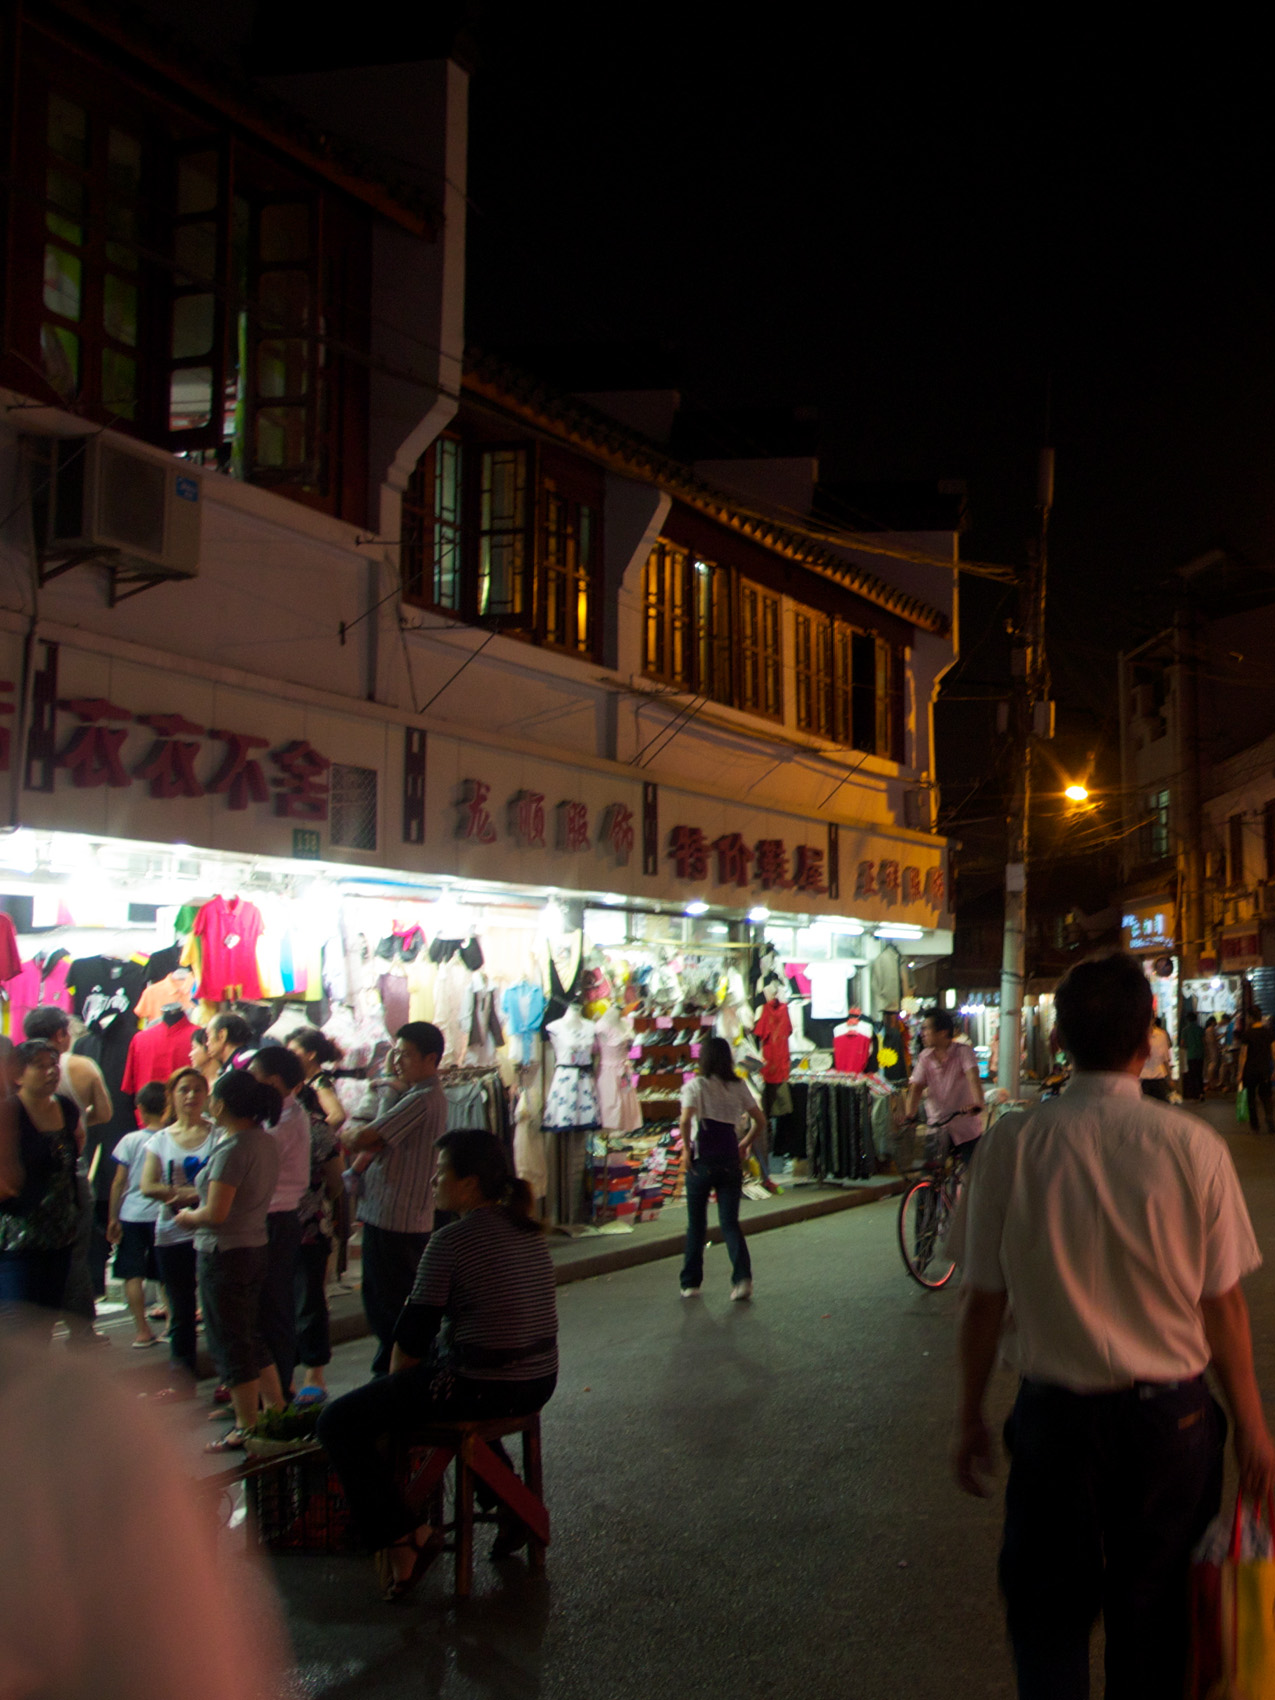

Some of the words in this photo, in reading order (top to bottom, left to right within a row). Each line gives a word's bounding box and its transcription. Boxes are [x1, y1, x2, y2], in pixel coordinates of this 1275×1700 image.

[52, 697, 330, 821] 衣衣不舍
[668, 824, 830, 894] 特价鞋屋
